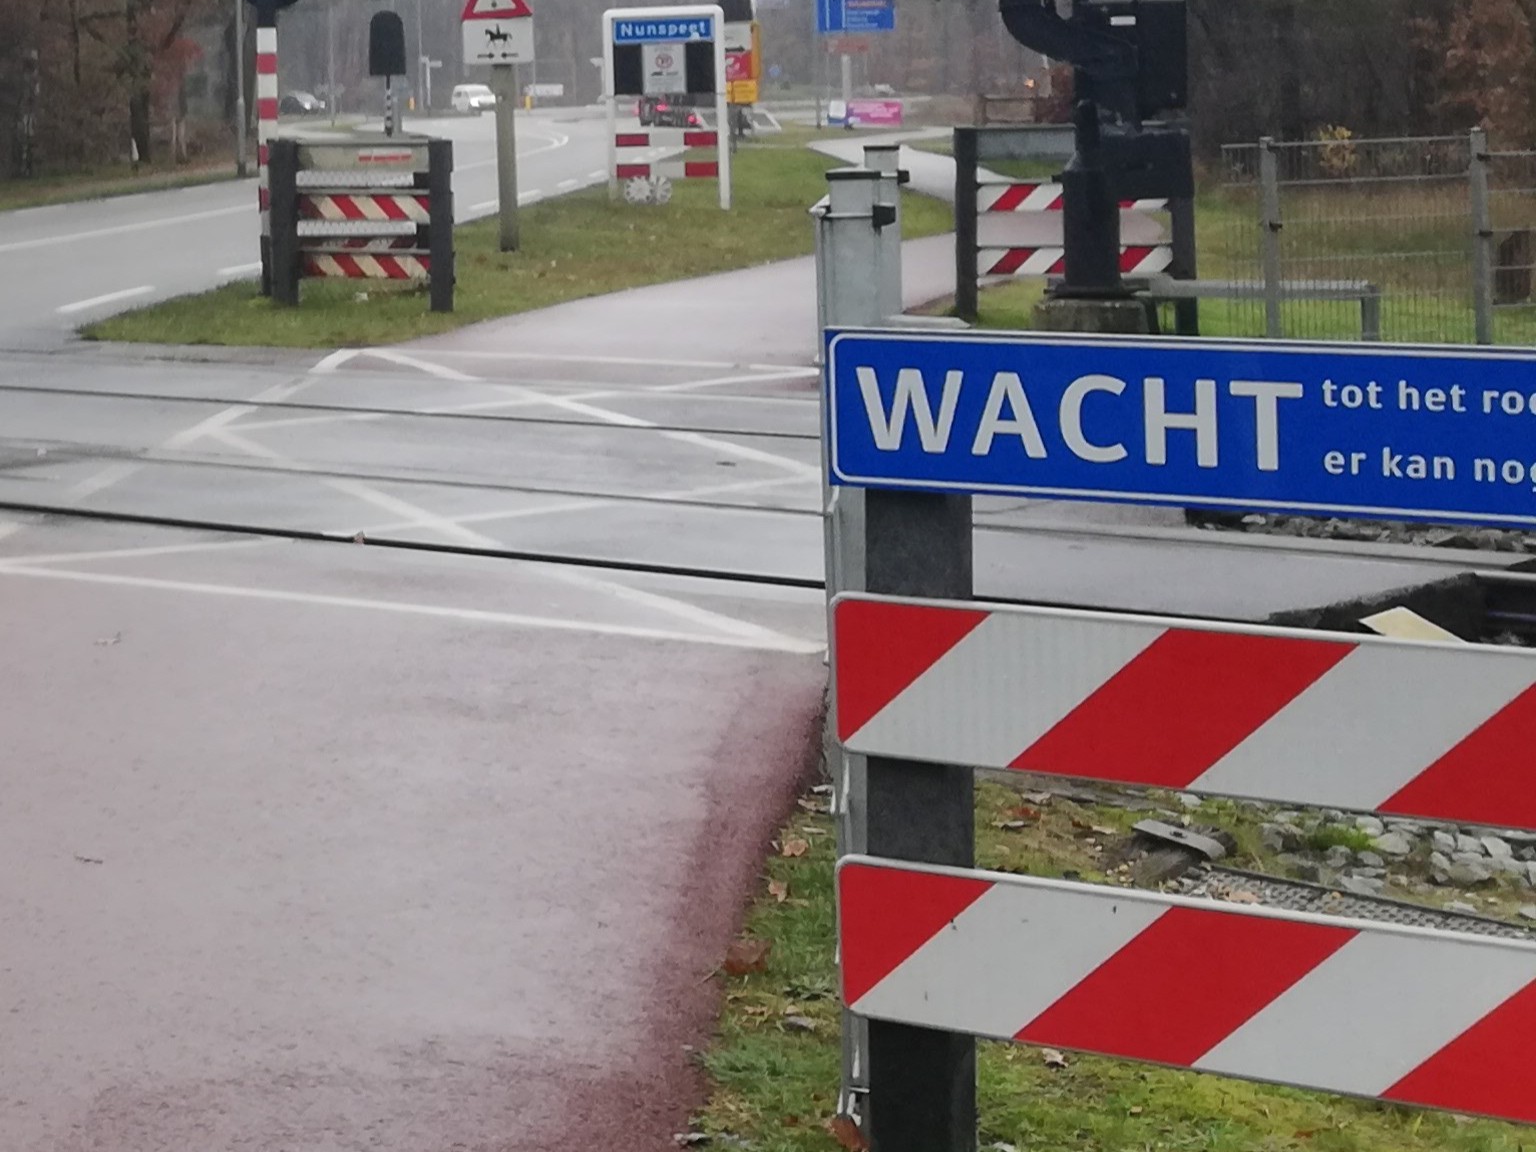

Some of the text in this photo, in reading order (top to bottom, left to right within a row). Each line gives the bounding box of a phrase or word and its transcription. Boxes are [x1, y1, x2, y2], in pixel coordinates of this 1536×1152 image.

[620, 21, 706, 37] Nunspeet
[1321, 378, 1383, 410] tot
[1397, 379, 1467, 412] het
[855, 365, 1305, 471] WACHT
[1323, 450, 1368, 476] er
[1381, 446, 1456, 481] kan
